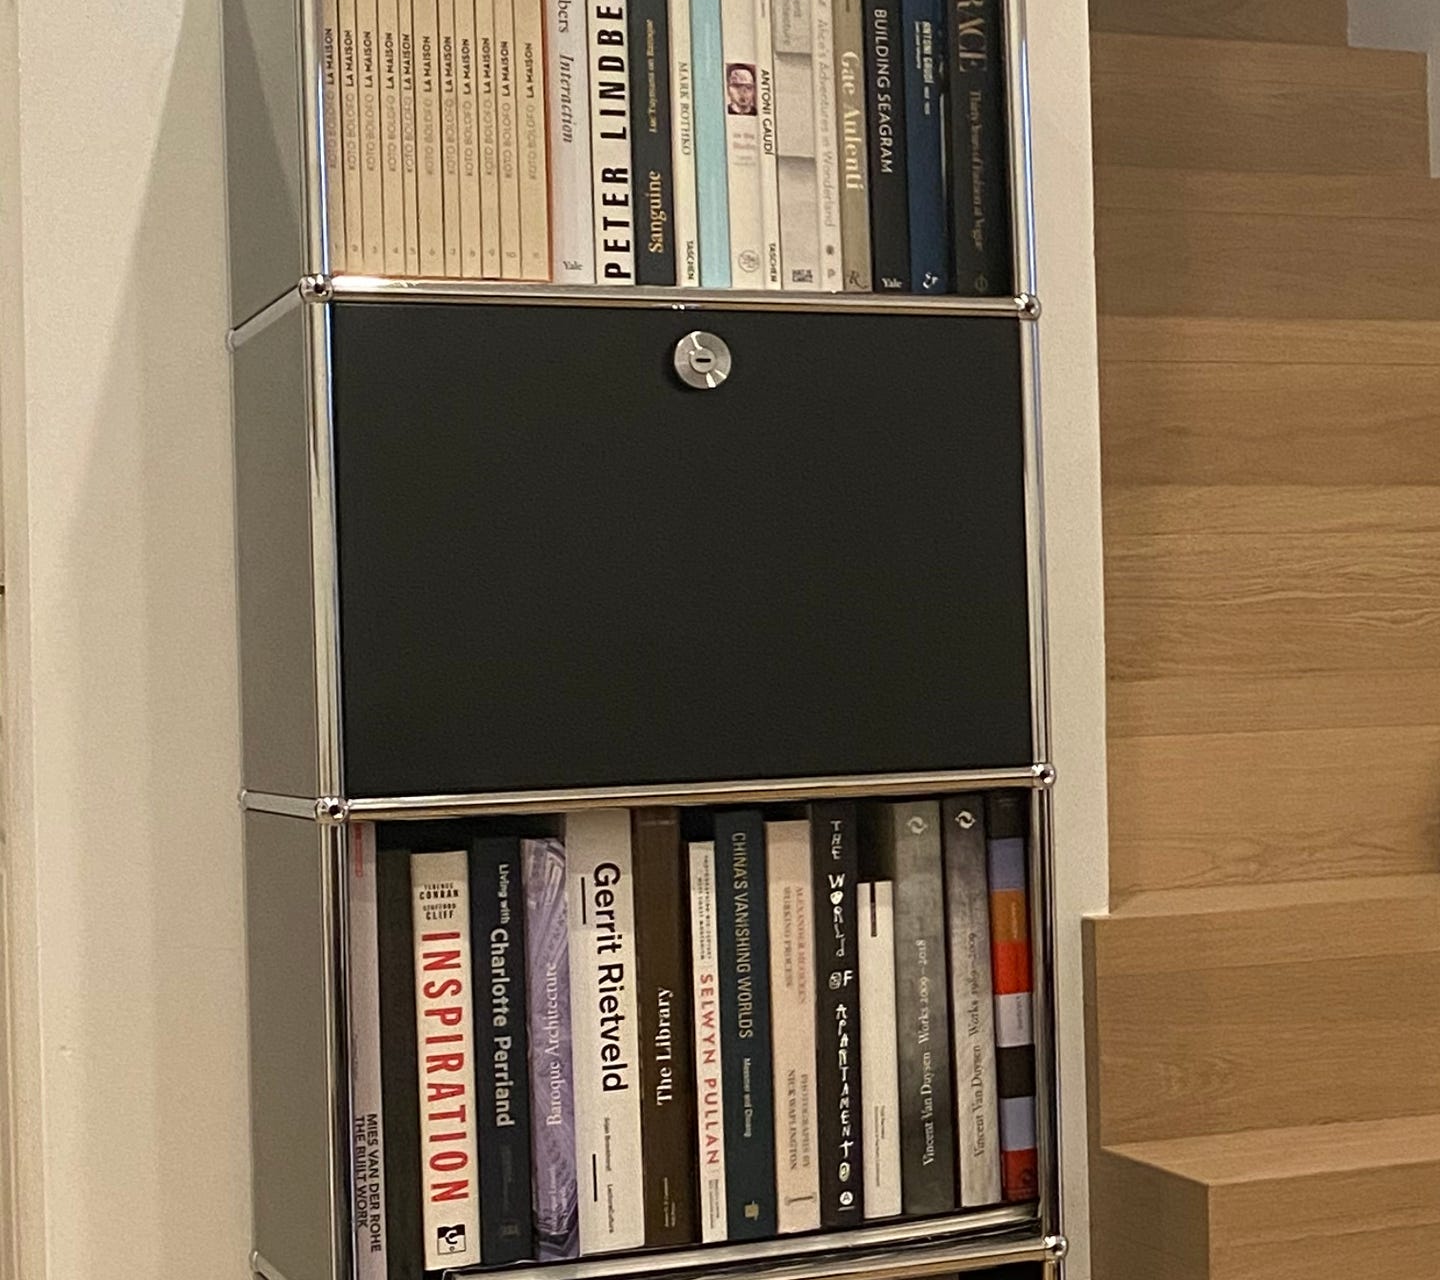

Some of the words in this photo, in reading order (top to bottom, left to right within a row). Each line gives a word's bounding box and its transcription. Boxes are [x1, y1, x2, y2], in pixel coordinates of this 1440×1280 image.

[324, 28, 333, 68] MAISON
[344, 30, 353, 69] MAISON
[363, 31, 373, 71] MAISON
[385, 32, 394, 72] MAISON
[402, 34, 411, 73] MAISON
[423, 36, 431, 76] MAISON
[443, 36, 452, 76] MAISON
[461, 38, 470, 78] MAISON
[481, 37, 490, 77] MAISON
[500, 41, 509, 80] MAISON
[525, 43, 533, 82] MAISON
[874, 8, 891, 89] BUILDING
[760, 69, 773, 114] ANTONI
[840, 51, 860, 95] Gae
[559, 54, 574, 143] Interaction
[843, 104, 864, 190] Aulenti
[877, 94, 893, 174] SEAGRAM
[602, 167, 632, 279] PETER
[644, 170, 667, 254] Sanguine
[830, 820, 843, 860] THE
[425, 910, 455, 921] CLIFF
[594, 862, 623, 955] Gerrit
[734, 892, 751, 973] VANISHING
[490, 928, 511, 1028] Charlotte
[543, 962, 561, 1055] Architecture
[597, 963, 628, 1092] Rietveld
[655, 987, 674, 1062] Library
[701, 974, 716, 1065] SELWYN
[736, 974, 754, 1039] WORLDS
[421, 931, 470, 1204] INSPIRATION
[493, 1036, 515, 1127] Perriand
[656, 1066, 673, 1106] The
[545, 1061, 566, 1126] Baroque
[920, 1097, 933, 1120] Van
[356, 1116, 366, 1142] THE
[366, 1113, 378, 1145] MIES
[703, 1078, 720, 1165] PULLAN
[357, 1146, 367, 1182] BUILT
[368, 1149, 379, 1180] VAN
[922, 1122, 934, 1167] Vincent
[357, 1184, 368, 1229] WORK
[369, 1183, 380, 1211] DER
[370, 1214, 382, 1253] ROHE
